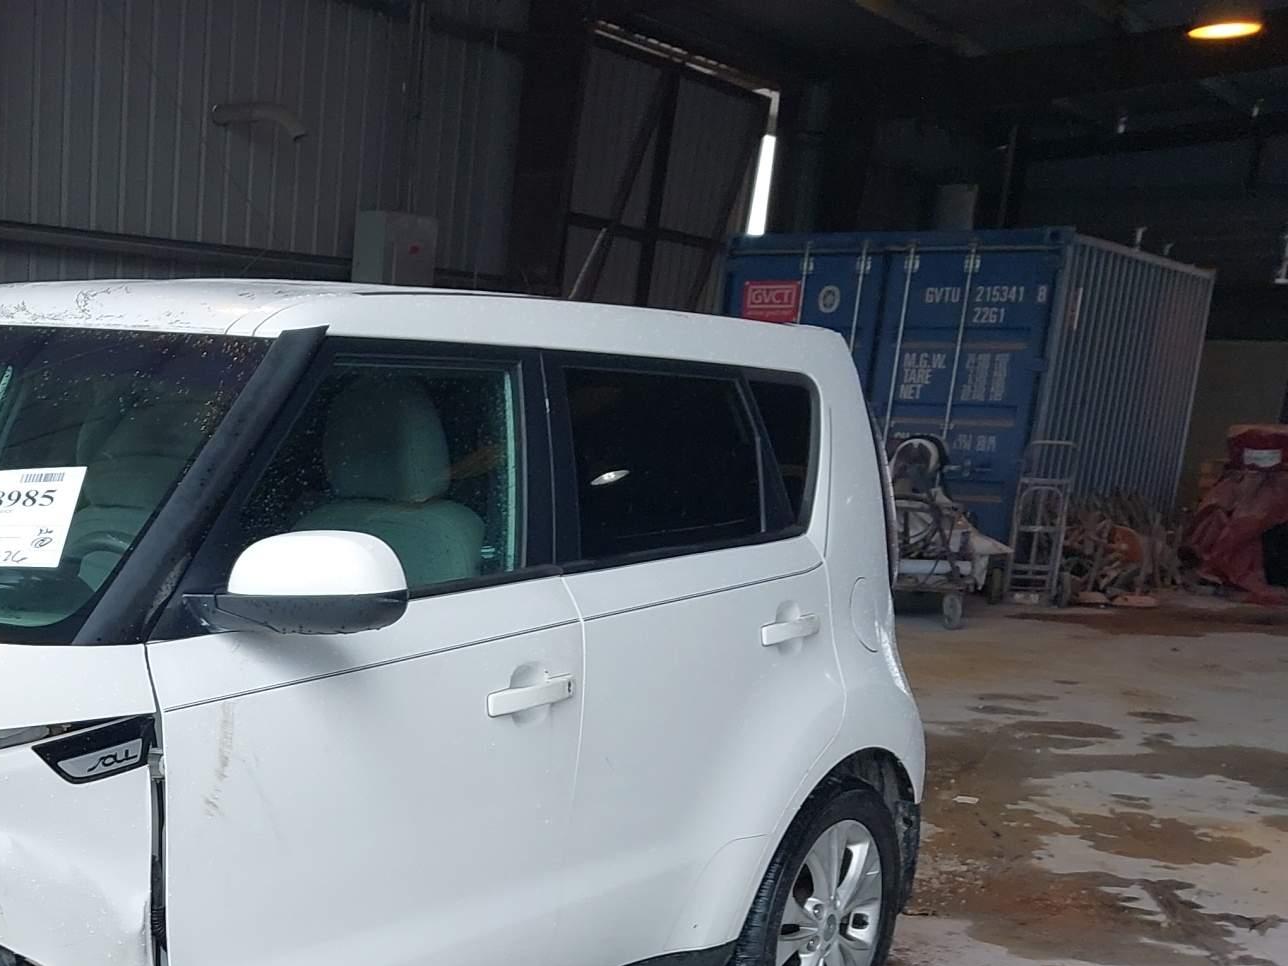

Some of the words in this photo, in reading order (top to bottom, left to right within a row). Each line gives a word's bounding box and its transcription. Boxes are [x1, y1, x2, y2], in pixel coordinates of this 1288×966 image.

[751, 289, 792, 304] GVCT
[925, 287, 961, 303] GVTU
[975, 285, 1025, 302] 215341
[903, 353, 947, 369] M.G.W.
[903, 369, 933, 384] TARE
[898, 384, 924, 399] NET
